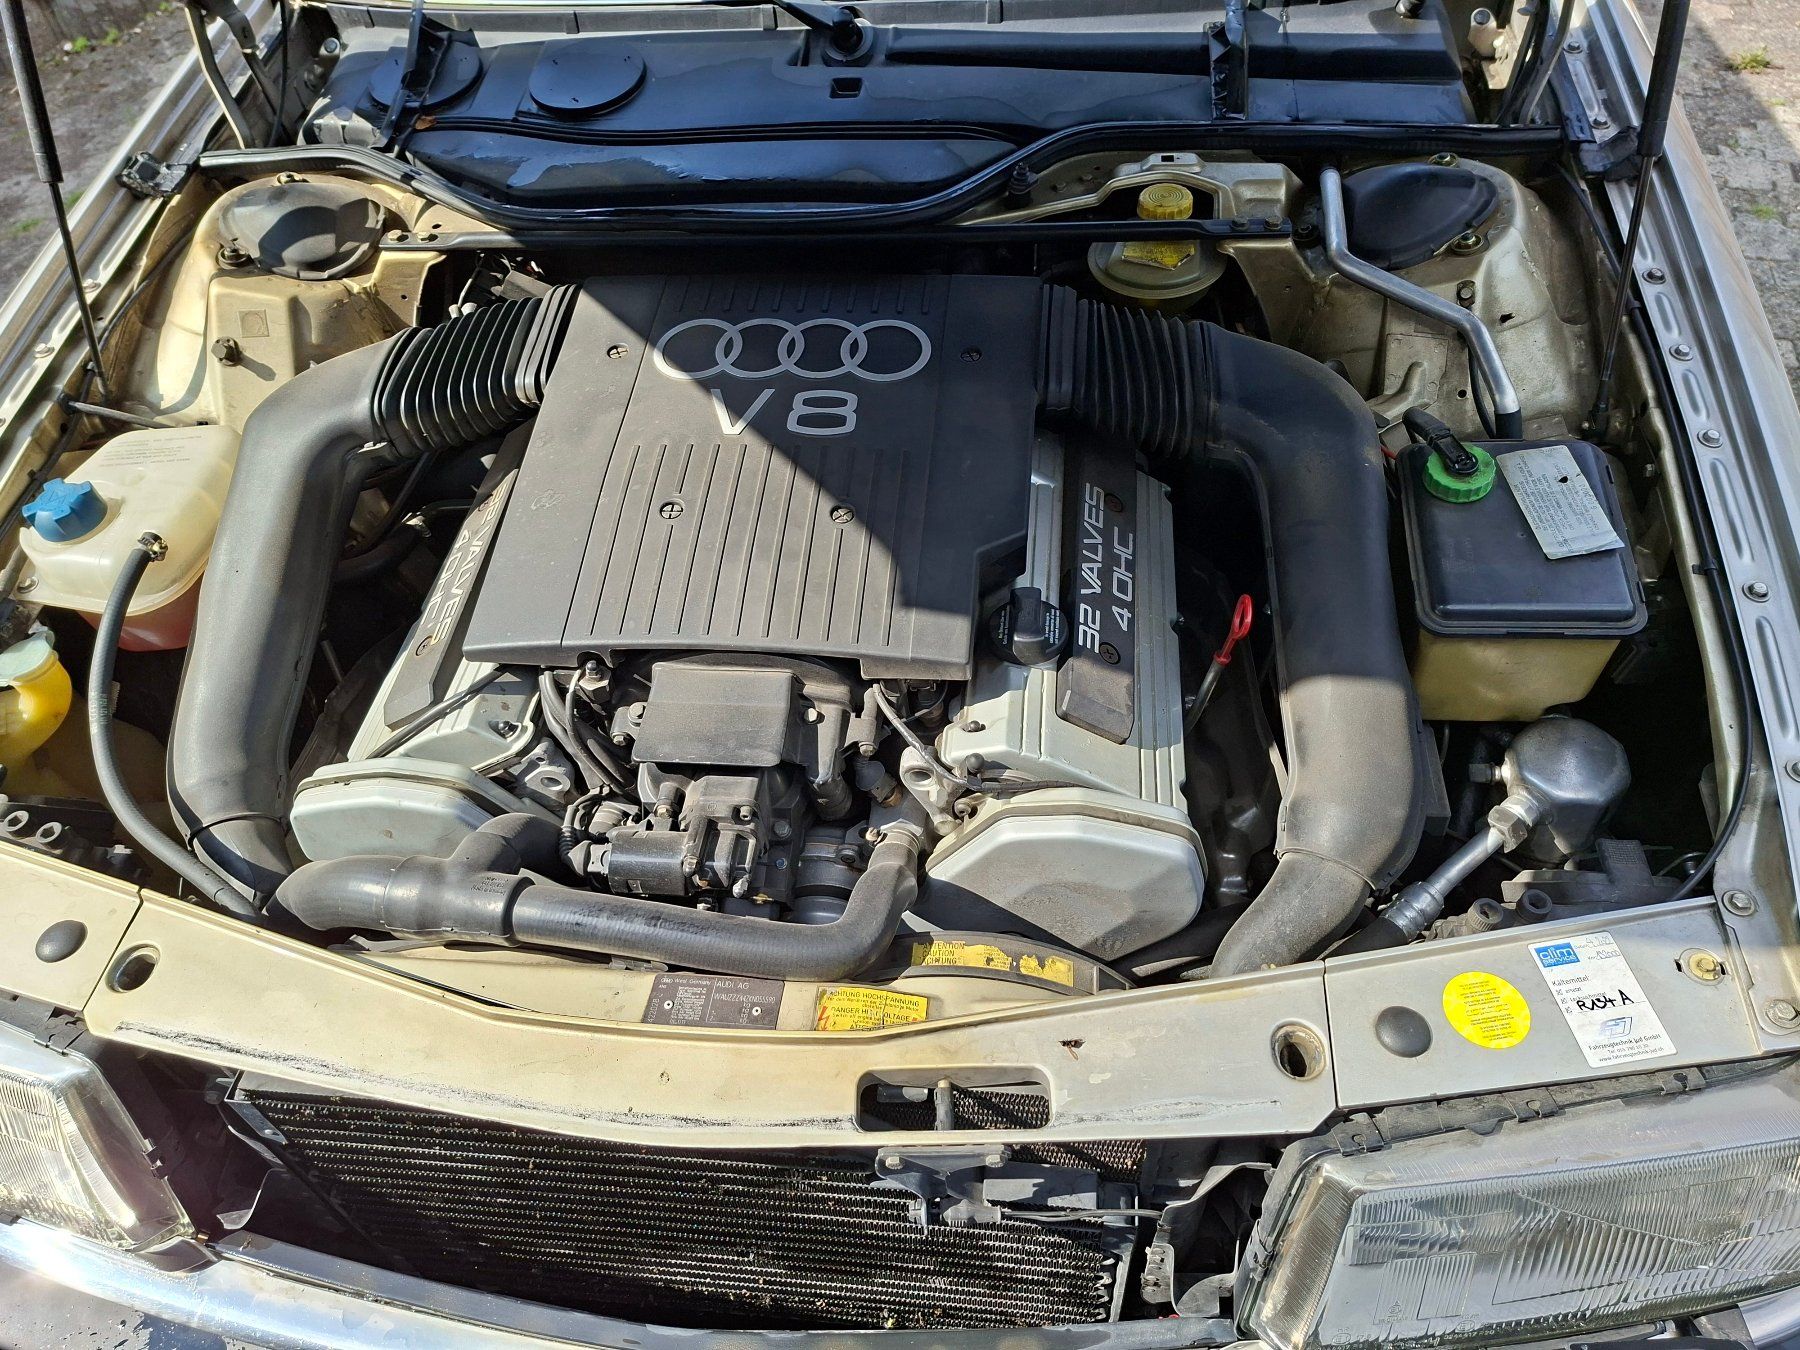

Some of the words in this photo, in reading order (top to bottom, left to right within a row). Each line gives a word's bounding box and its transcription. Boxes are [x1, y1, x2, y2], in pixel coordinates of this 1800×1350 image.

[711, 388, 859, 436] V8
[1081, 482, 1105, 595] VALVES
[1112, 526, 1133, 602] OHC
[1077, 602, 1101, 654] 32
[1112, 605, 1132, 632] 4
[717, 980, 735, 988] AUDI
[738, 982, 750, 990] AG
[1618, 989, 1635, 1006] A
[862, 992, 920, 1007] HOCHSPANNUNG
[882, 1011, 911, 1022] OLTAGE
